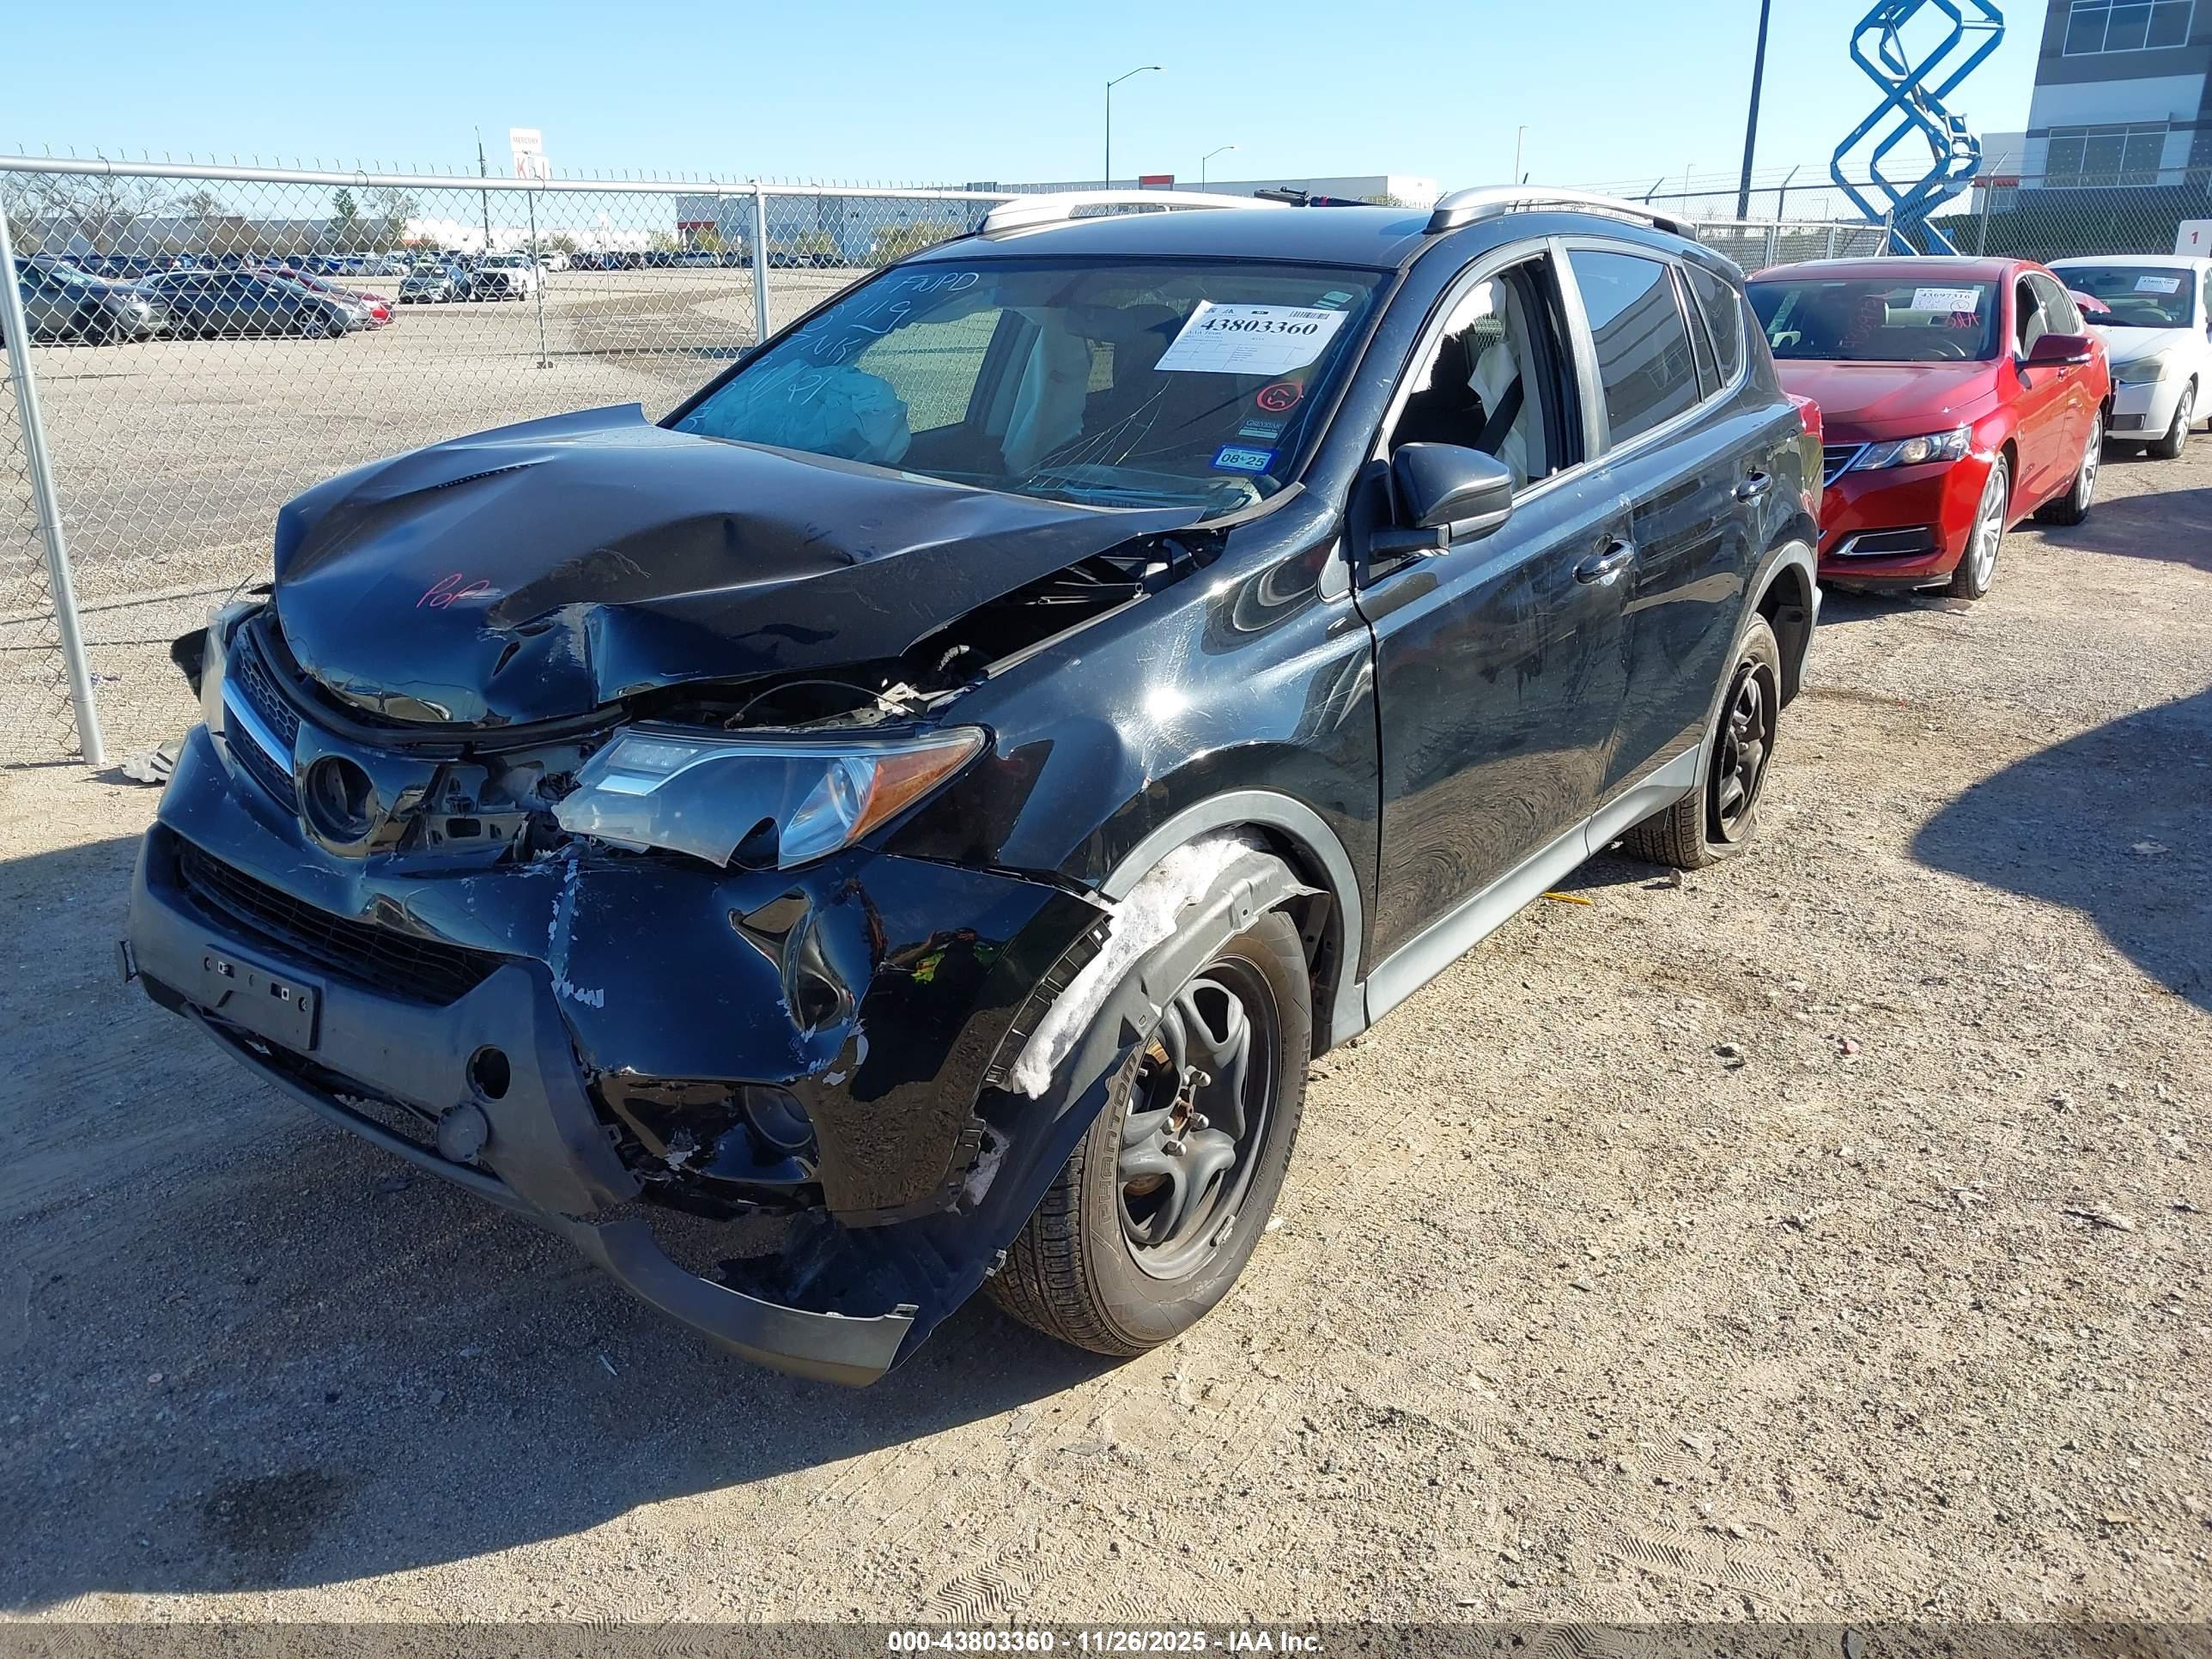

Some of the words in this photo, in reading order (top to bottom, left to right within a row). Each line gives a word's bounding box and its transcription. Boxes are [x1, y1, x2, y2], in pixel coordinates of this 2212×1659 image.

[2191, 231, 2199, 245] 1
[1200, 318, 1319, 336] 43803360
[1221, 453, 1241, 464] 08
[1245, 456, 1267, 467] 25
